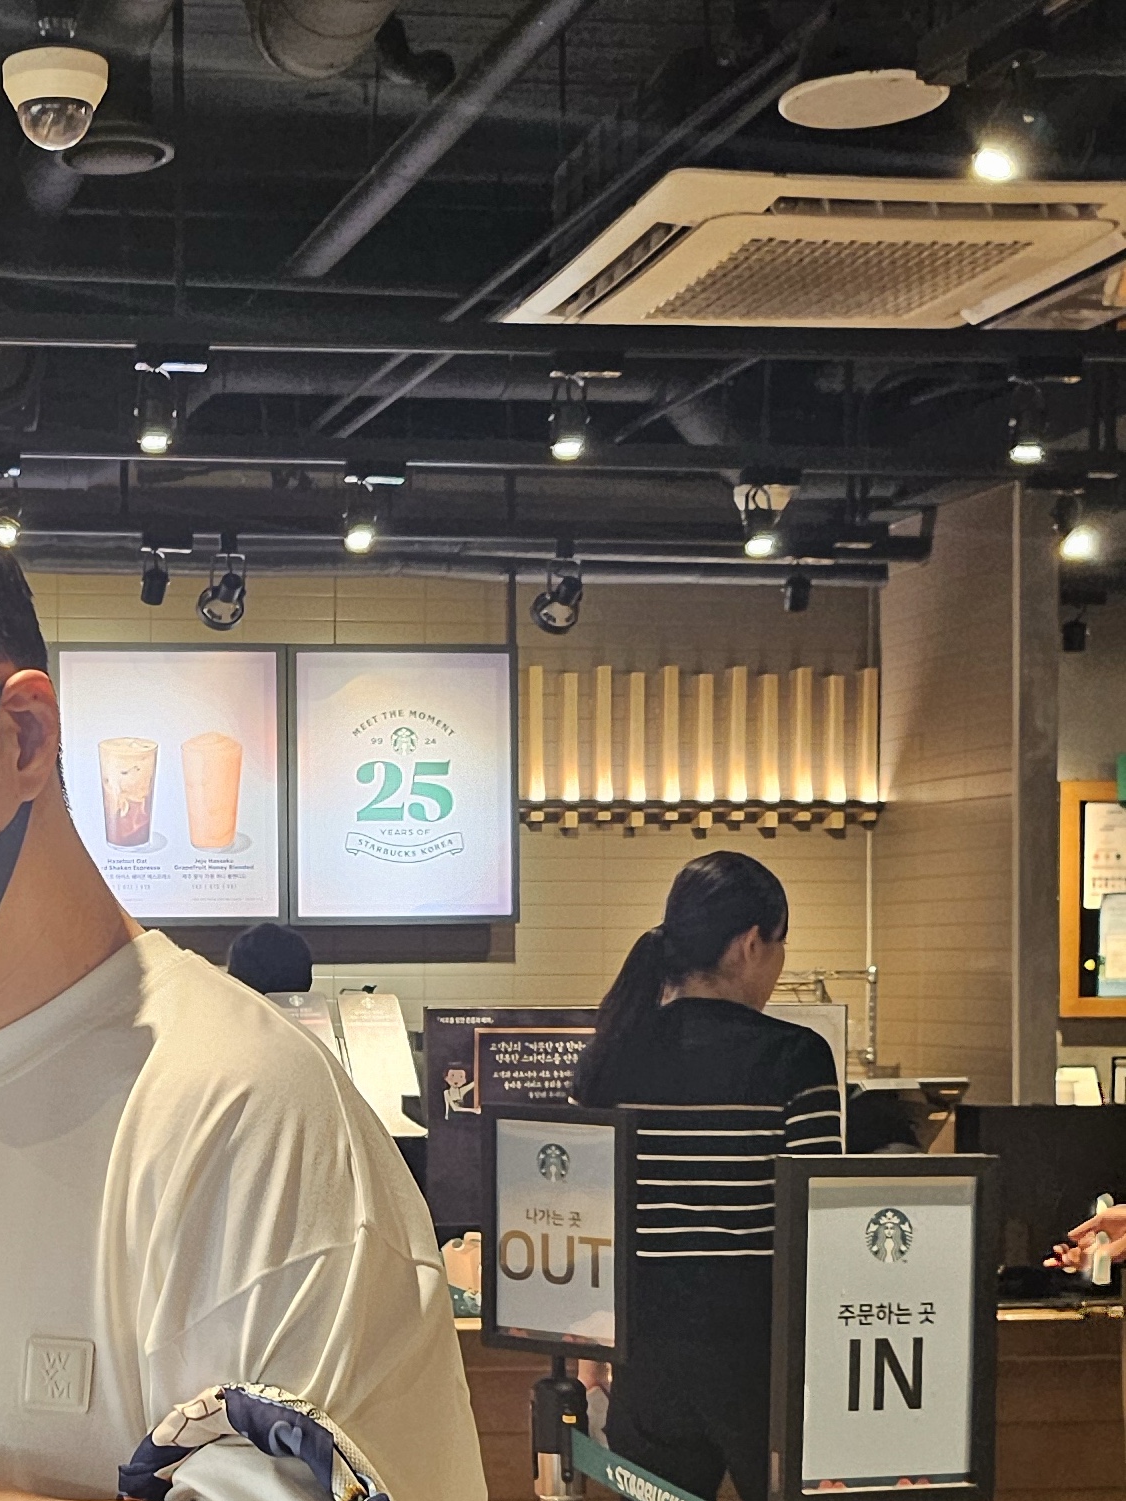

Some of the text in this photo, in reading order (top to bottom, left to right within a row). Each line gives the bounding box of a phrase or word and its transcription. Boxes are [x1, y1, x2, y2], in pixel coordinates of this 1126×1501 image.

[352, 709, 456, 737] MEET THE MOMENT
[370, 737, 437, 745] 99 24
[356, 759, 454, 822] 25
[379, 828, 431, 836] YEARS OF
[357, 838, 454, 858] STARBUCKS KOREA
[526, 1208, 582, 1228] 나가는 곳
[499, 1229, 612, 1289] OUT
[837, 1302, 937, 1327] 주문하는 곳
[848, 1336, 924, 1412] IN
